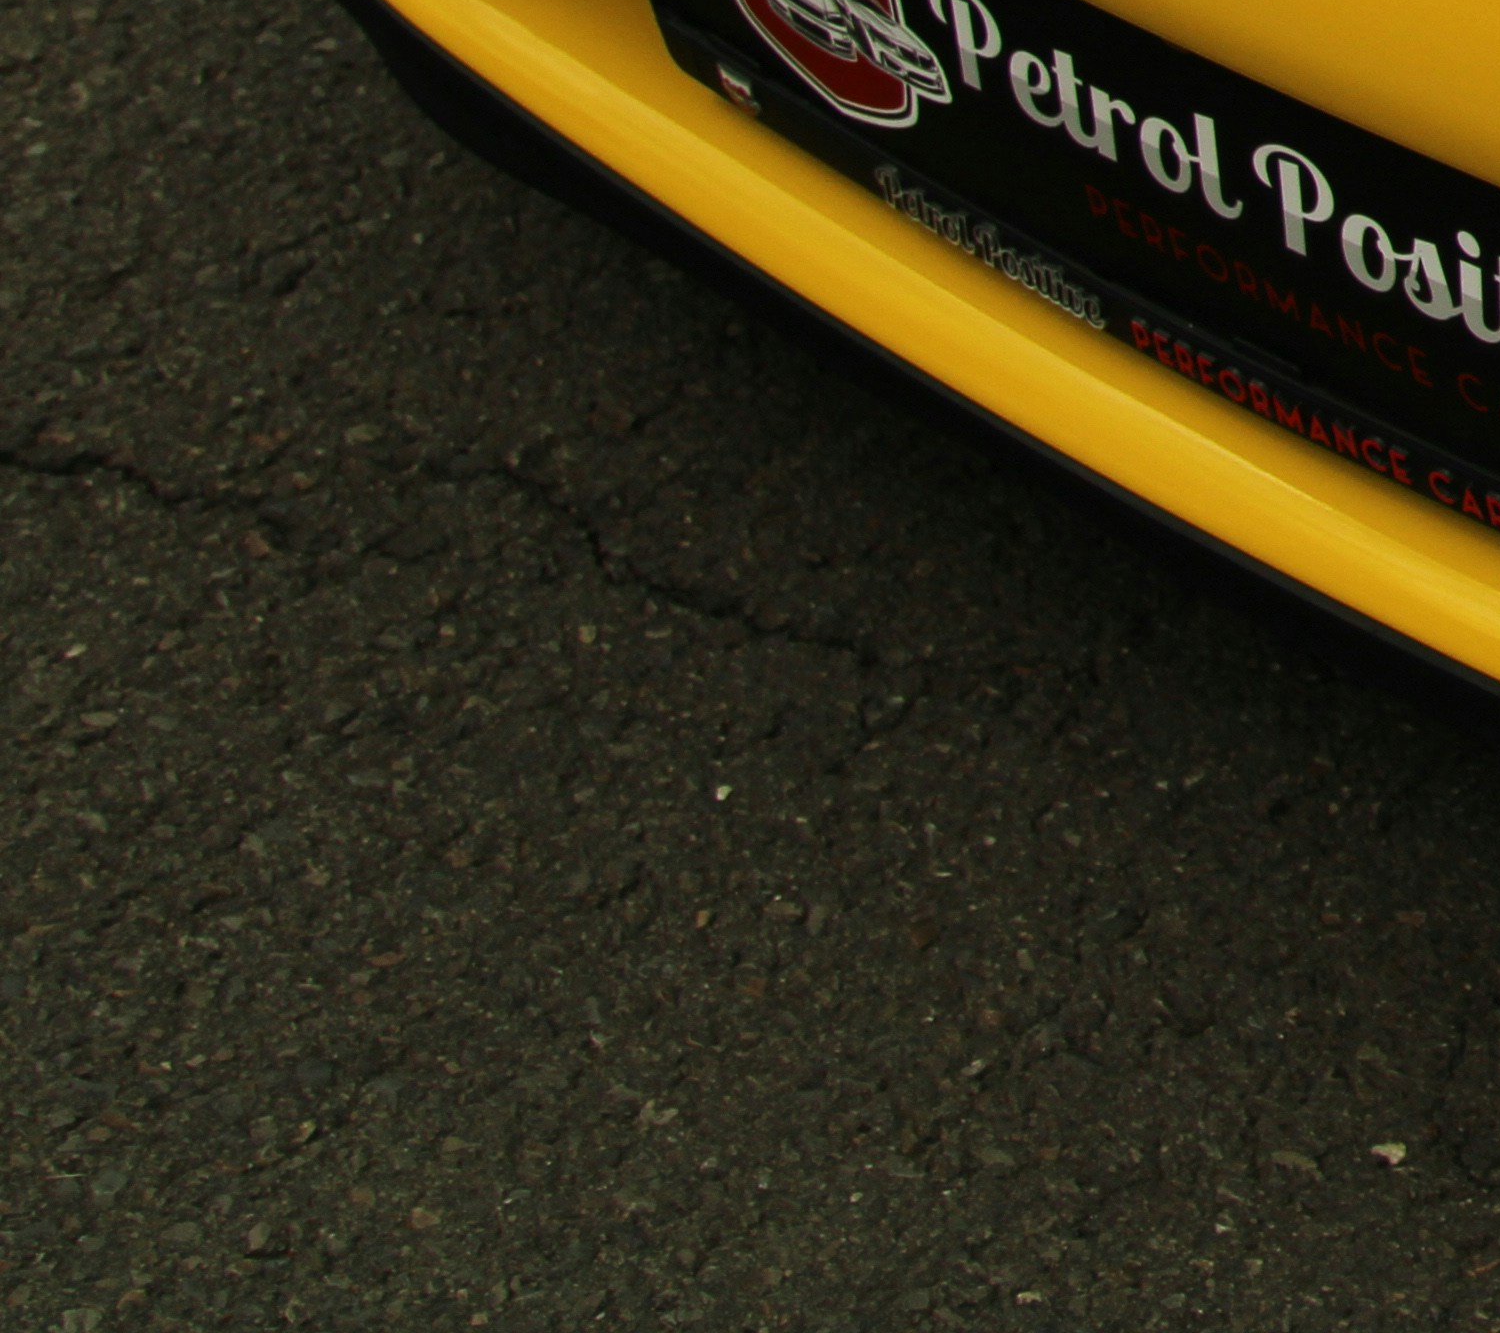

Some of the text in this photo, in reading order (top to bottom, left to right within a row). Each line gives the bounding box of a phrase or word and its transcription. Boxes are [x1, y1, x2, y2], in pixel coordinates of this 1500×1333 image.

[874, 164, 1107, 330] Petrol Positive
[1084, 183, 1435, 388] PERFORMANCE
[1129, 317, 1413, 485] PERFORMANCE
